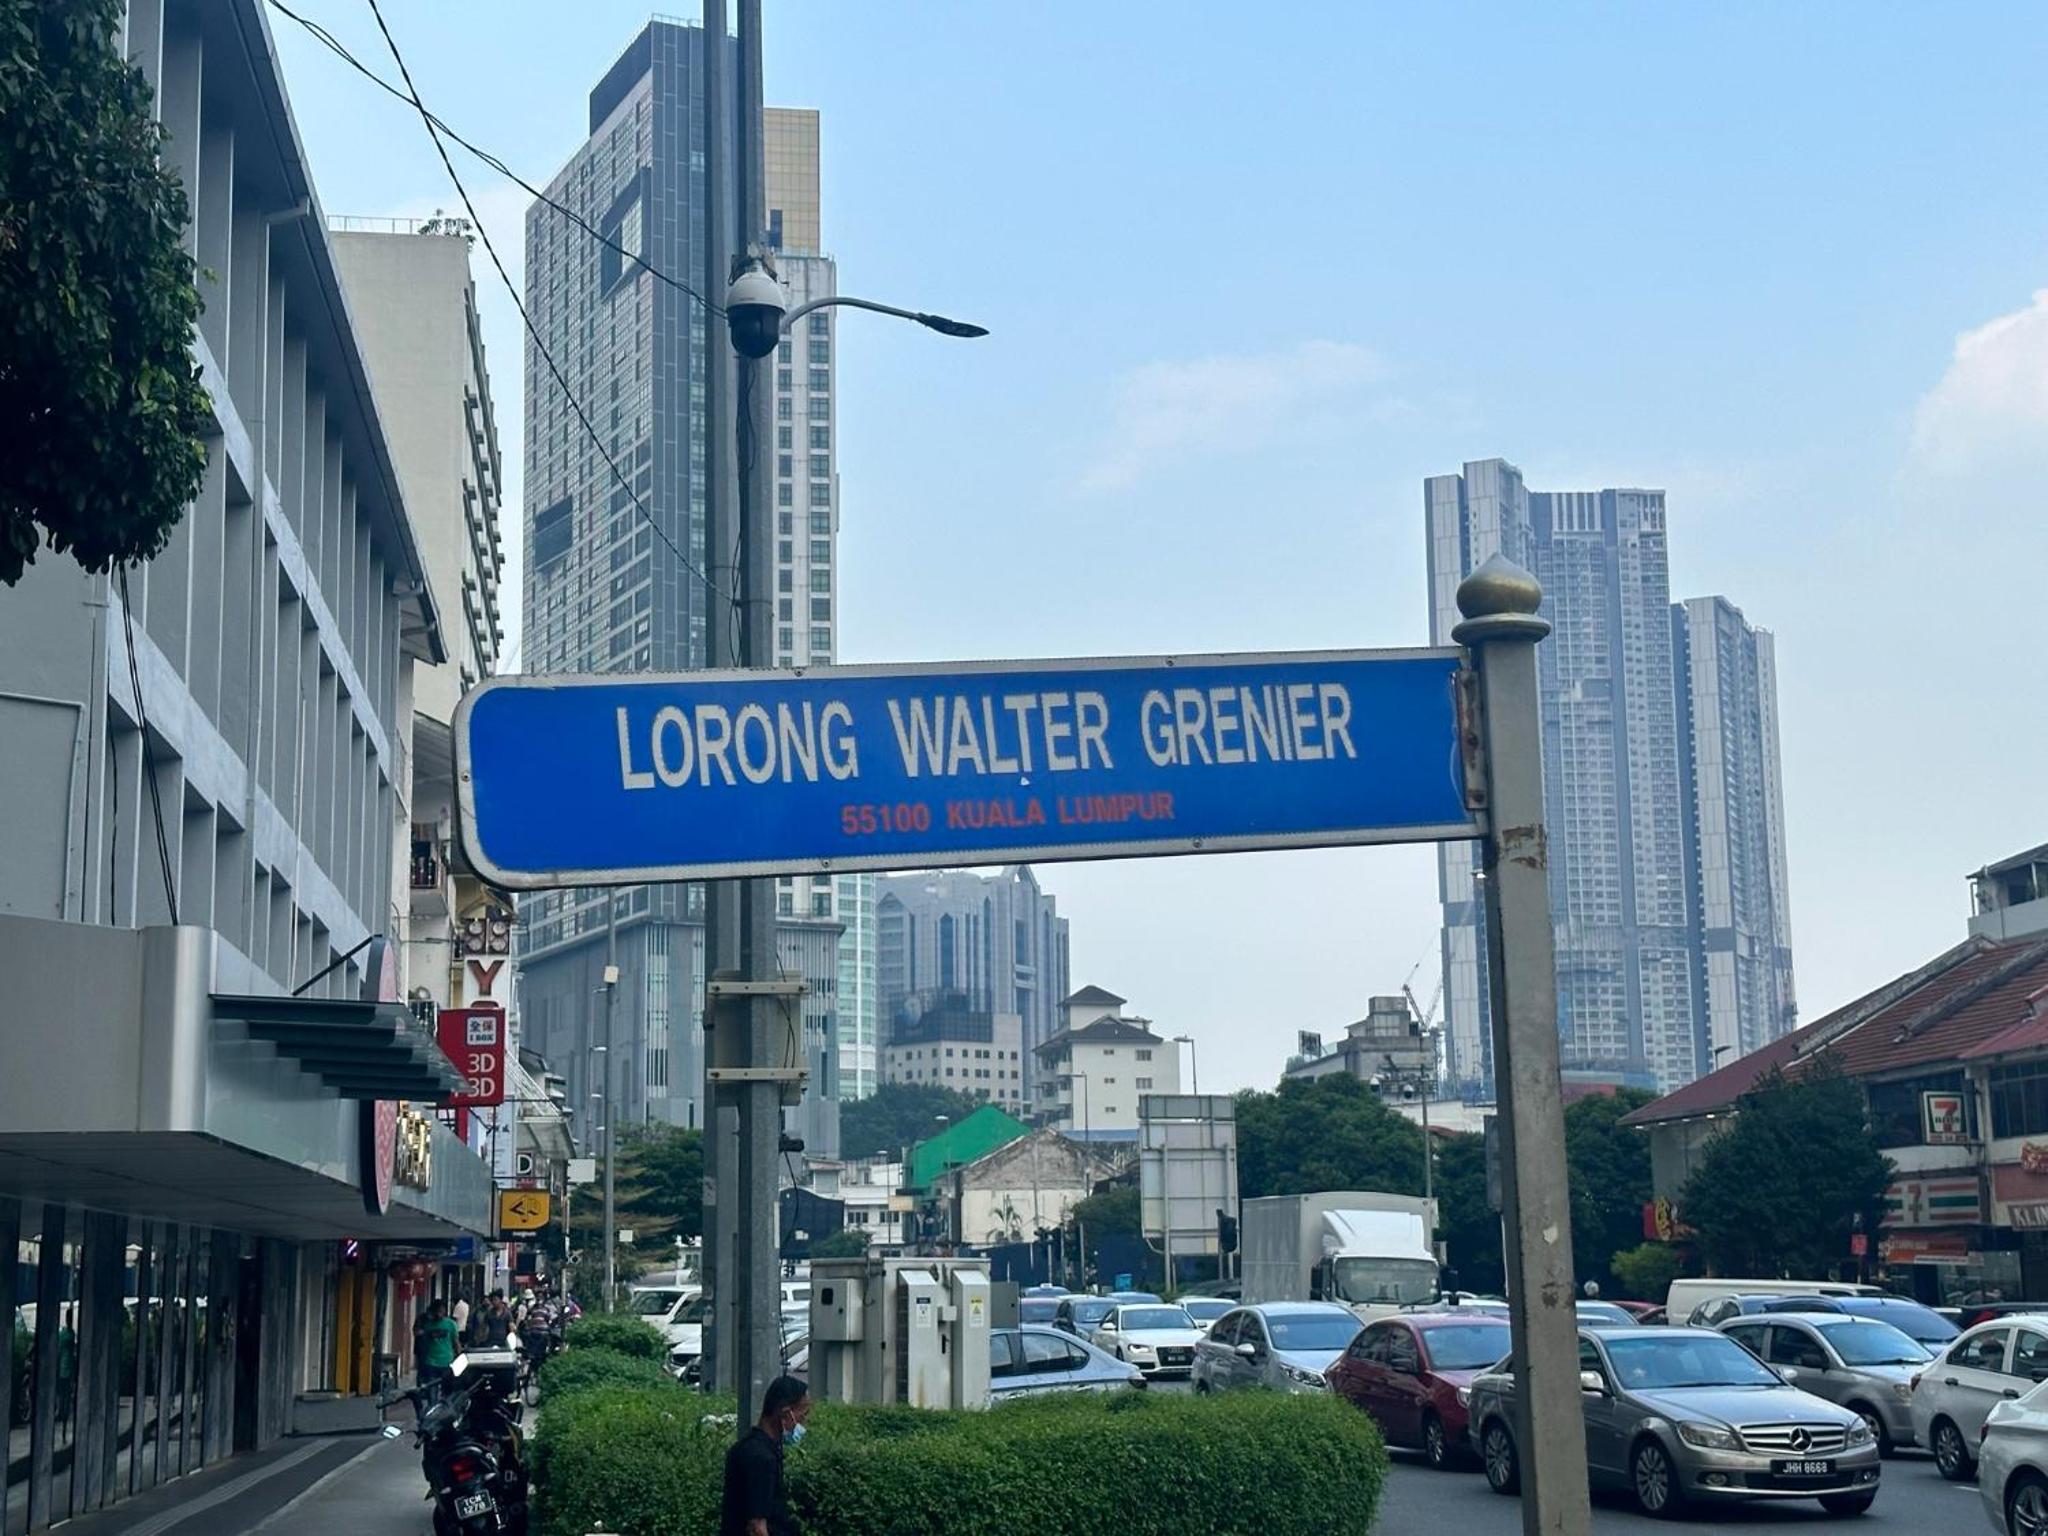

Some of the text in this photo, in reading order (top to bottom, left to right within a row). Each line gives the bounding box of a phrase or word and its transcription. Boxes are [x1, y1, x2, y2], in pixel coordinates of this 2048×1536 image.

[616, 683, 1357, 790] LORONG WALTER GRENIER
[841, 791, 1175, 835] 55100 KUALA LUMPUR
[467, 1053, 496, 1073] 3D
[1782, 1461, 1802, 1473] JHH
